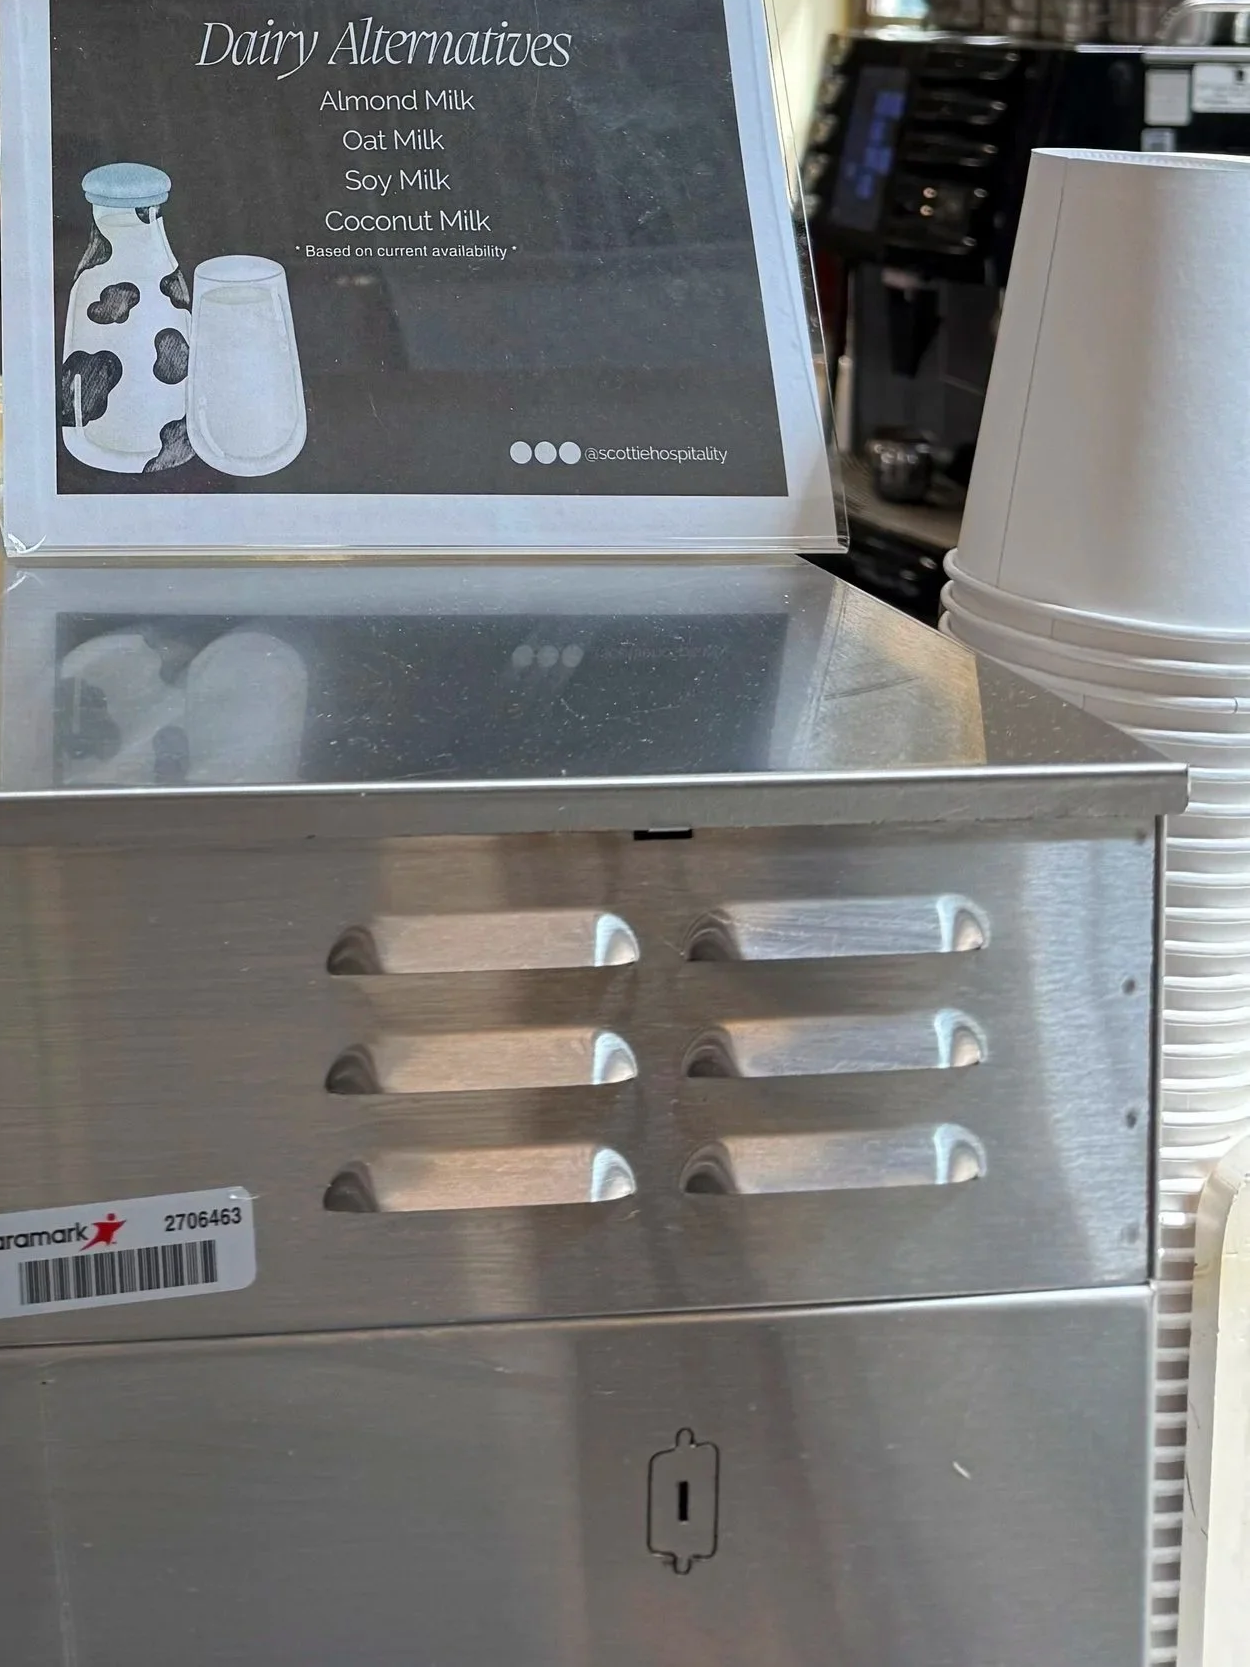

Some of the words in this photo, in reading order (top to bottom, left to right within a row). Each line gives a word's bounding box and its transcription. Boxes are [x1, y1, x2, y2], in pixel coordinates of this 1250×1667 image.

[195, 18, 319, 80] Dairy
[327, 16, 572, 69] Alternatives
[319, 89, 418, 111] Almond
[425, 89, 476, 111] Milk
[342, 129, 388, 151] Oat
[393, 128, 445, 150] Milk
[345, 169, 392, 197] Soy
[399, 168, 451, 190] Milk
[325, 210, 434, 232] Coconut
[439, 209, 492, 232] Milk
[305, 244, 351, 258] Based
[355, 247, 373, 257] on
[377, 245, 428, 257] current
[432, 244, 508, 261] availability
[586, 445, 728, 465] @scottiehospitality
[164, 1207, 243, 1232] 2706463
